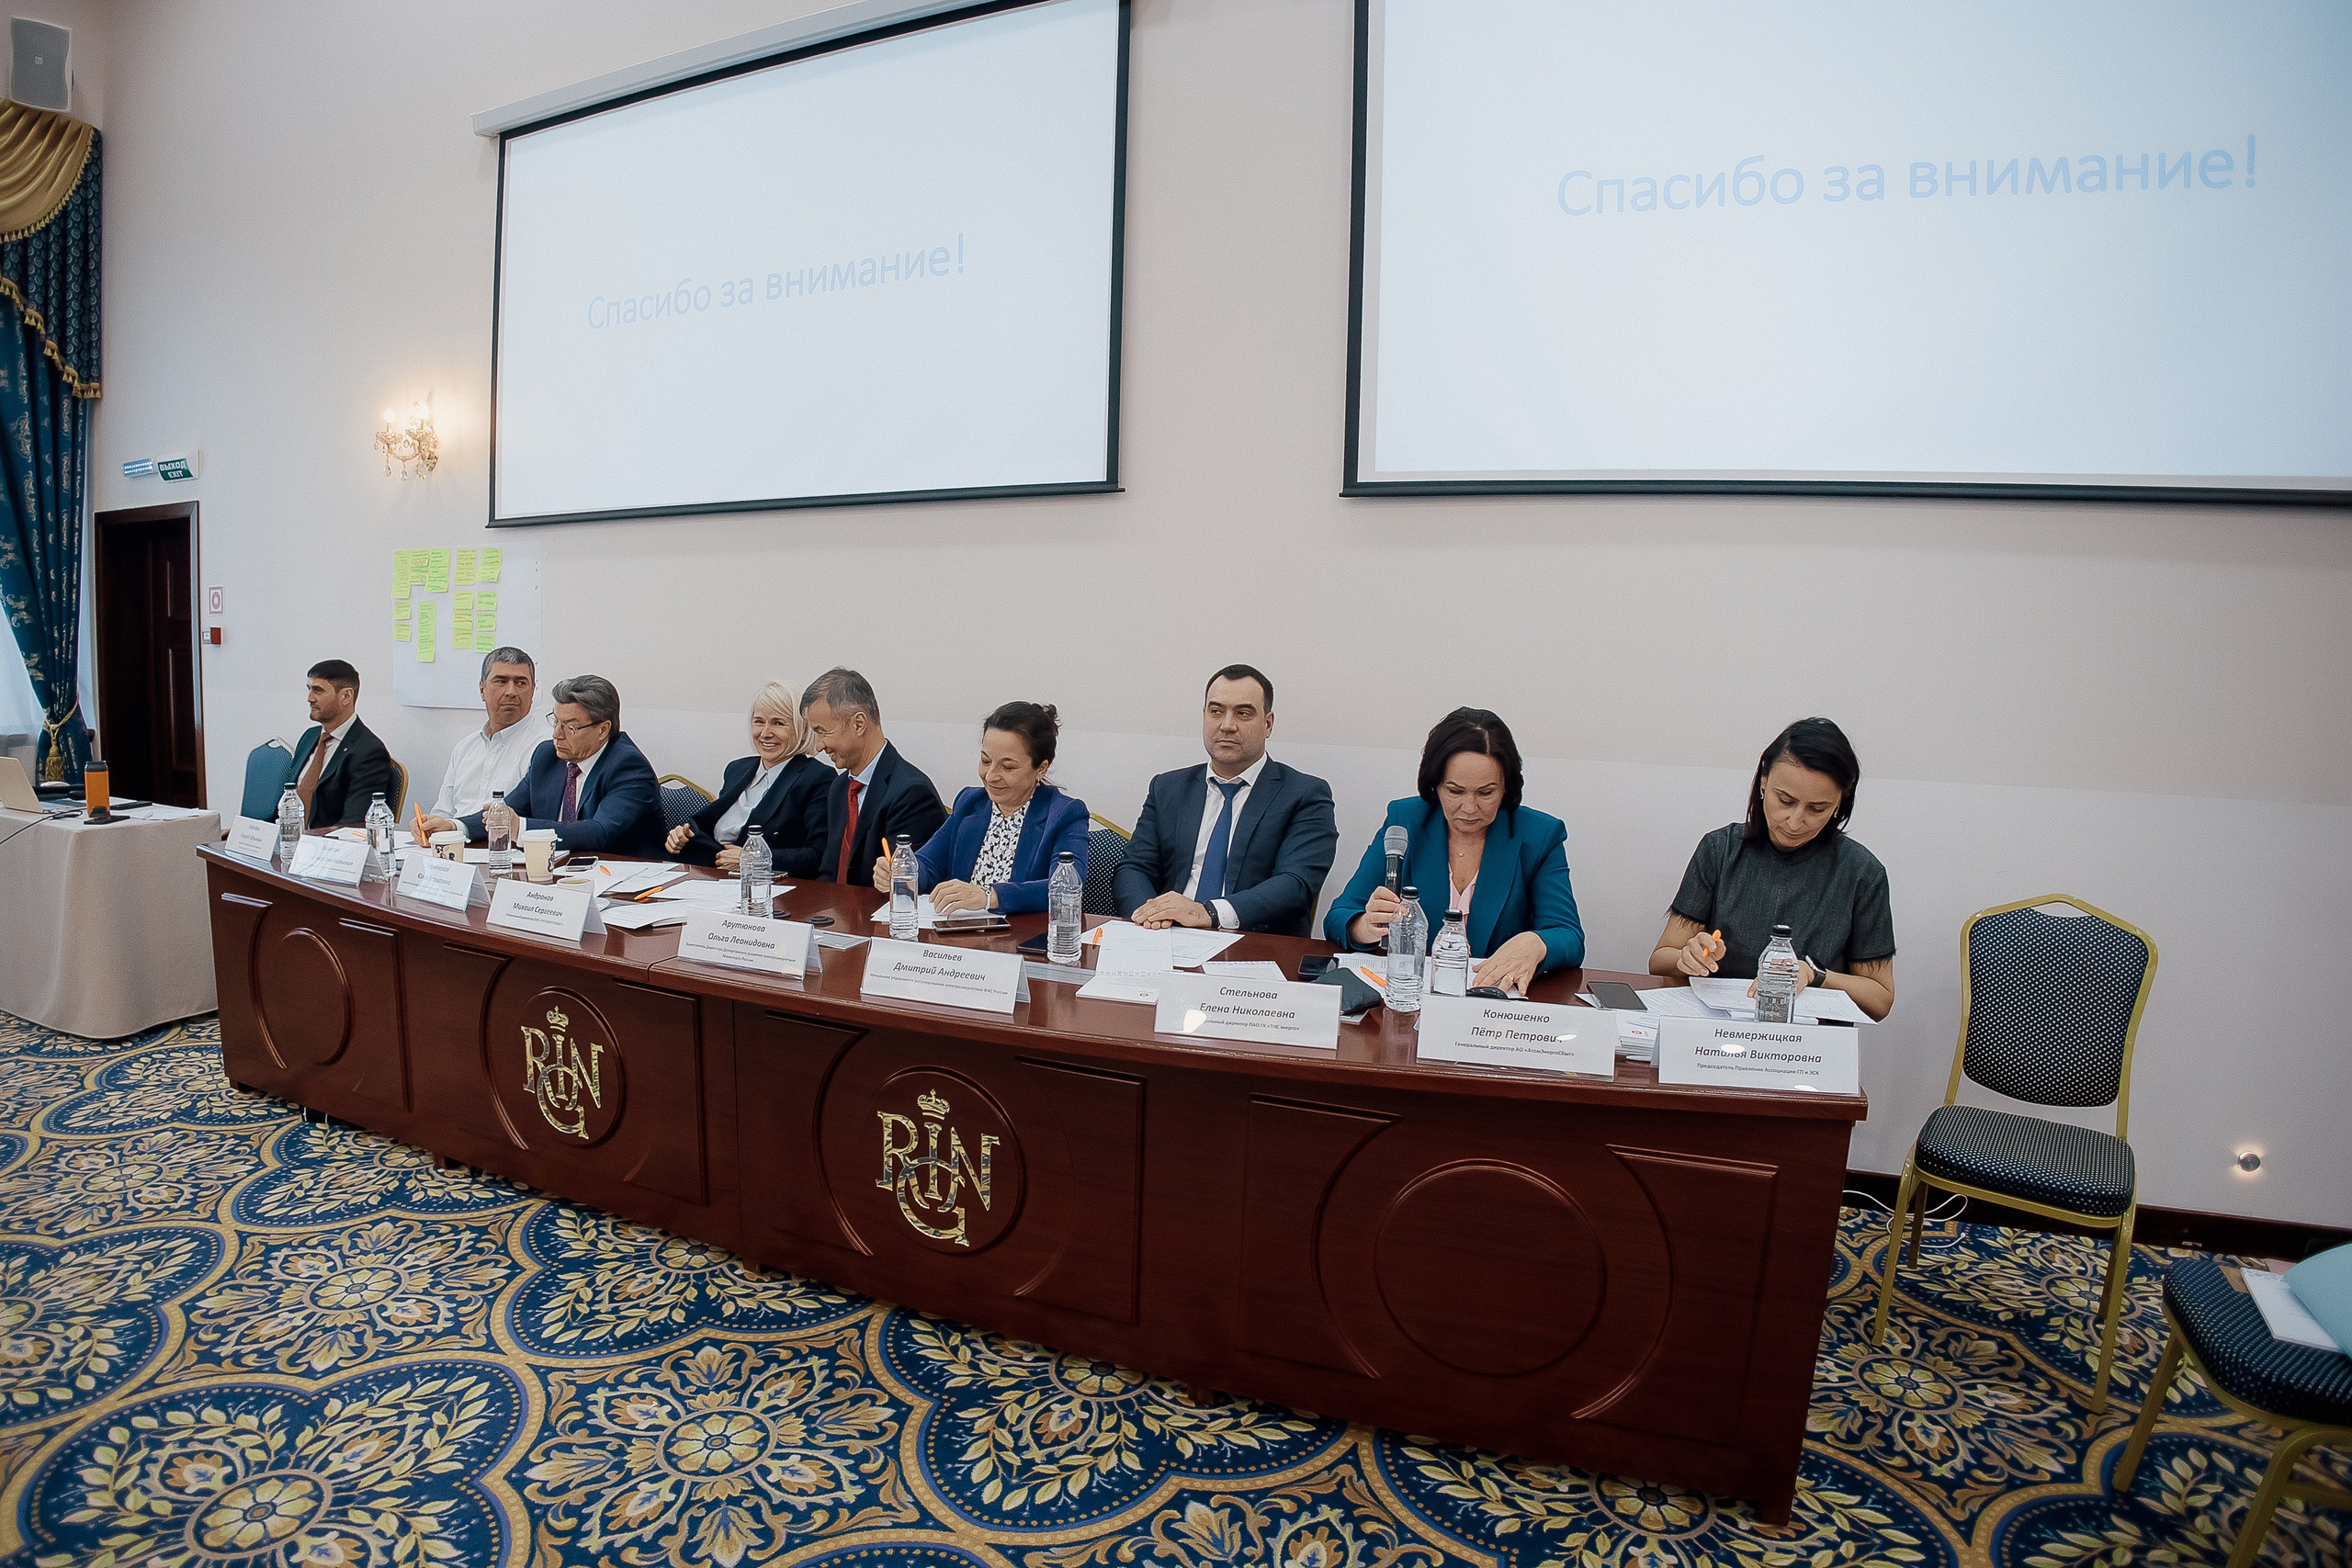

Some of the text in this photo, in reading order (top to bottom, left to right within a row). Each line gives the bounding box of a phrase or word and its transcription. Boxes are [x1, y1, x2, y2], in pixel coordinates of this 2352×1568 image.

[1556, 133, 2257, 216] Спасибо за внимание!
[586, 232, 966, 330] Спасибо за внимание!
[159, 460, 189, 471] ВЫХОД
[526, 891, 554, 901] Андронов
[513, 902, 563, 917] Михаил Сергеевич
[721, 919, 766, 932] Арутюнова
[707, 932, 775, 949] Ольга Леонидовна
[922, 949, 963, 962] Васильев
[893, 962, 986, 981] Дмитрий Андреевич
[1219, 987, 1278, 999] Стельнова
[1200, 1002, 1295, 1019] Елена Николаевна
[1483, 1009, 1550, 1023] Конюшенко
[1471, 1026, 1563, 1043] Пётр Петрови
[1714, 1029, 1803, 1043] Невмержицкая
[1454, 1041, 1489, 1049] Генеральный
[1749, 1049, 1822, 1064] Викторовна
[1696, 1063, 1735, 1071] Председатель
